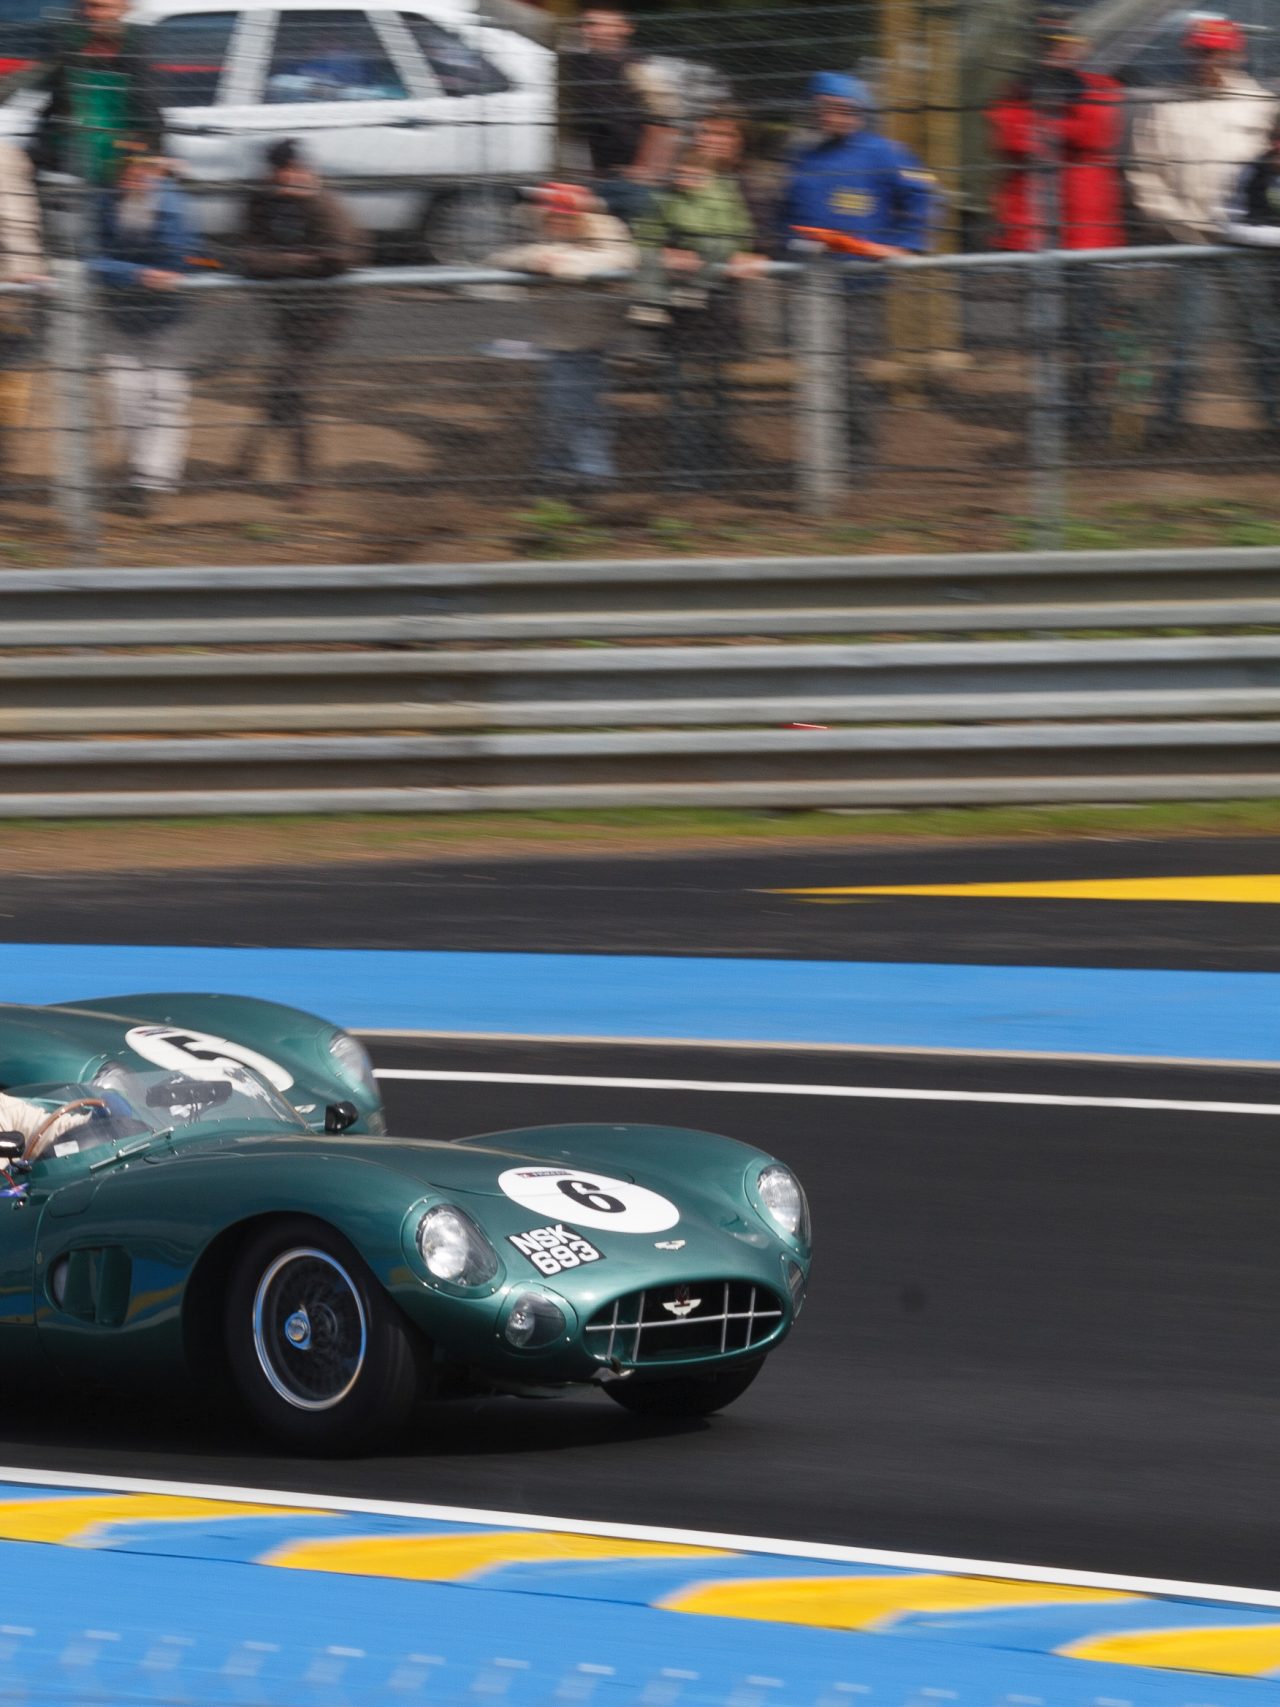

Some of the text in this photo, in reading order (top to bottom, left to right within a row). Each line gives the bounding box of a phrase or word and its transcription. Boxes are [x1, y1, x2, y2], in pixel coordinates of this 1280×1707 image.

[556, 1180, 627, 1213] 6
[509, 1224, 581, 1256] NSK
[531, 1240, 600, 1275] 693
